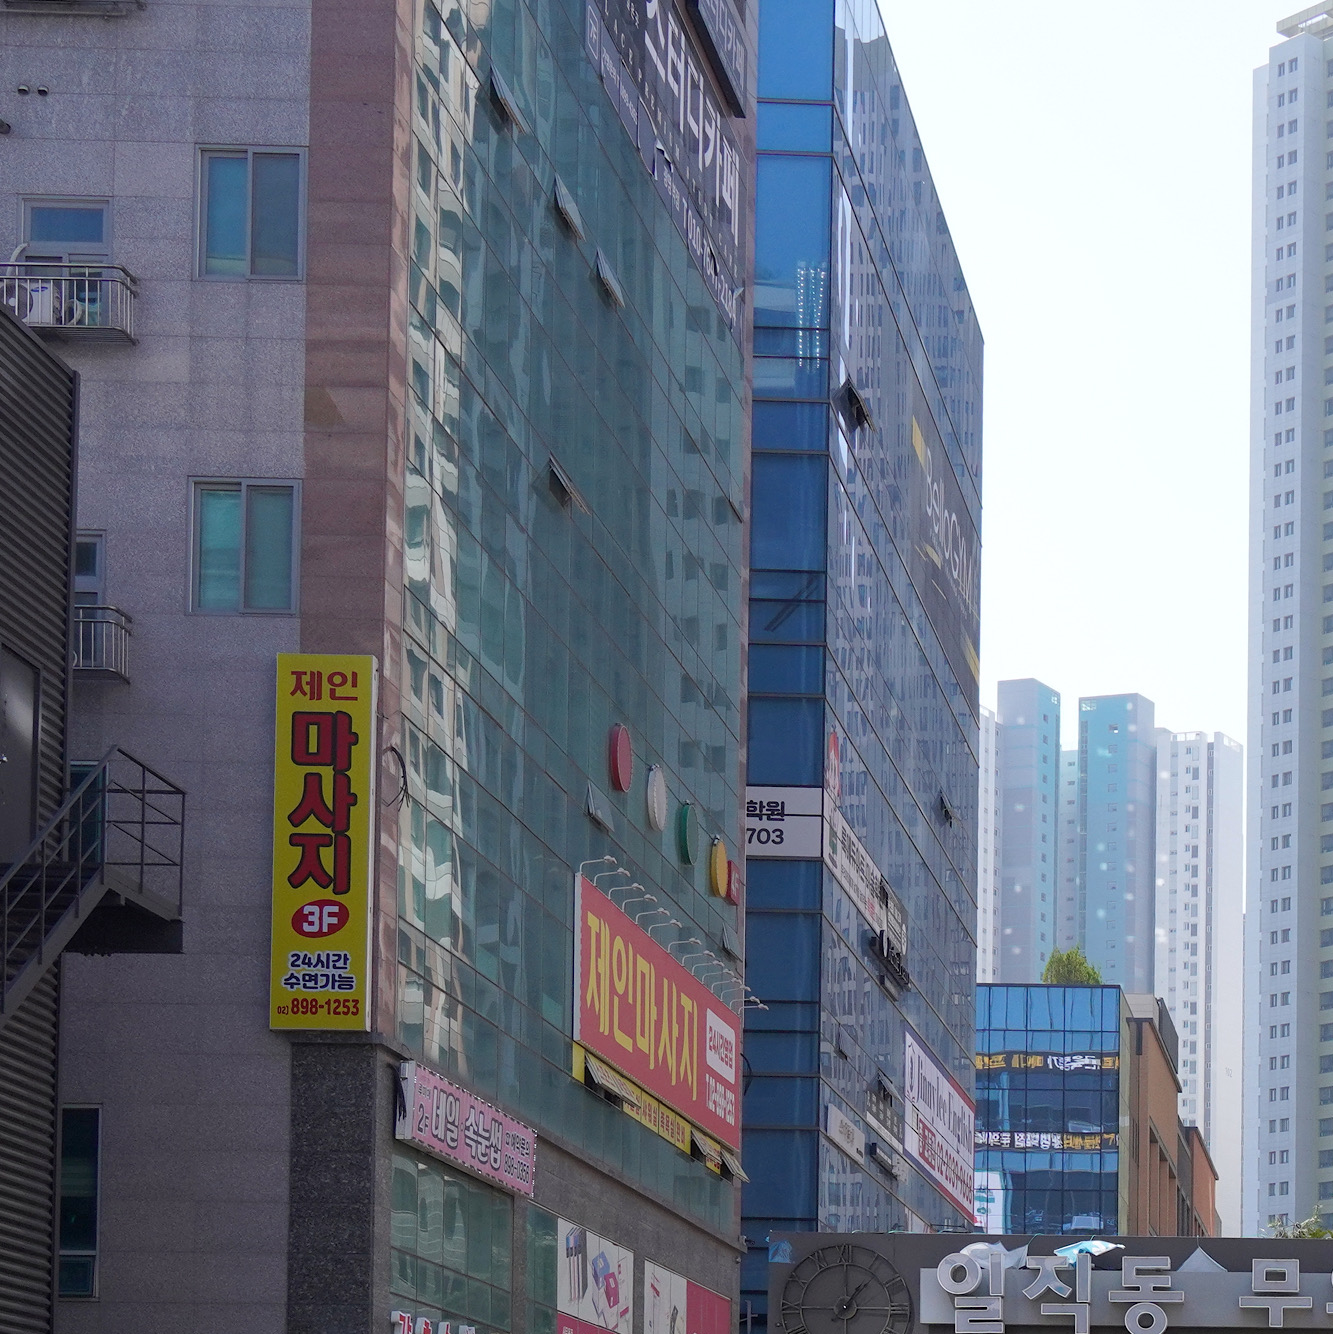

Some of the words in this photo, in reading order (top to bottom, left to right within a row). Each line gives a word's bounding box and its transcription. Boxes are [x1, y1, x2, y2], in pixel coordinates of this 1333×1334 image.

[289, 670, 359, 701] 제인
[288, 711, 358, 895] 마사지
[302, 905, 340, 934] 3F
[289, 951, 349, 971] 24시간
[282, 972, 355, 992] 수면가능
[290, 998, 360, 1018] 898-1253
[586, 910, 698, 1101] 제인마사지
[417, 1103, 429, 1137] 2F
[431, 1086, 460, 1150] 네일
[464, 1104, 503, 1172] 속눈썹
[948, 1091, 973, 1153] English
